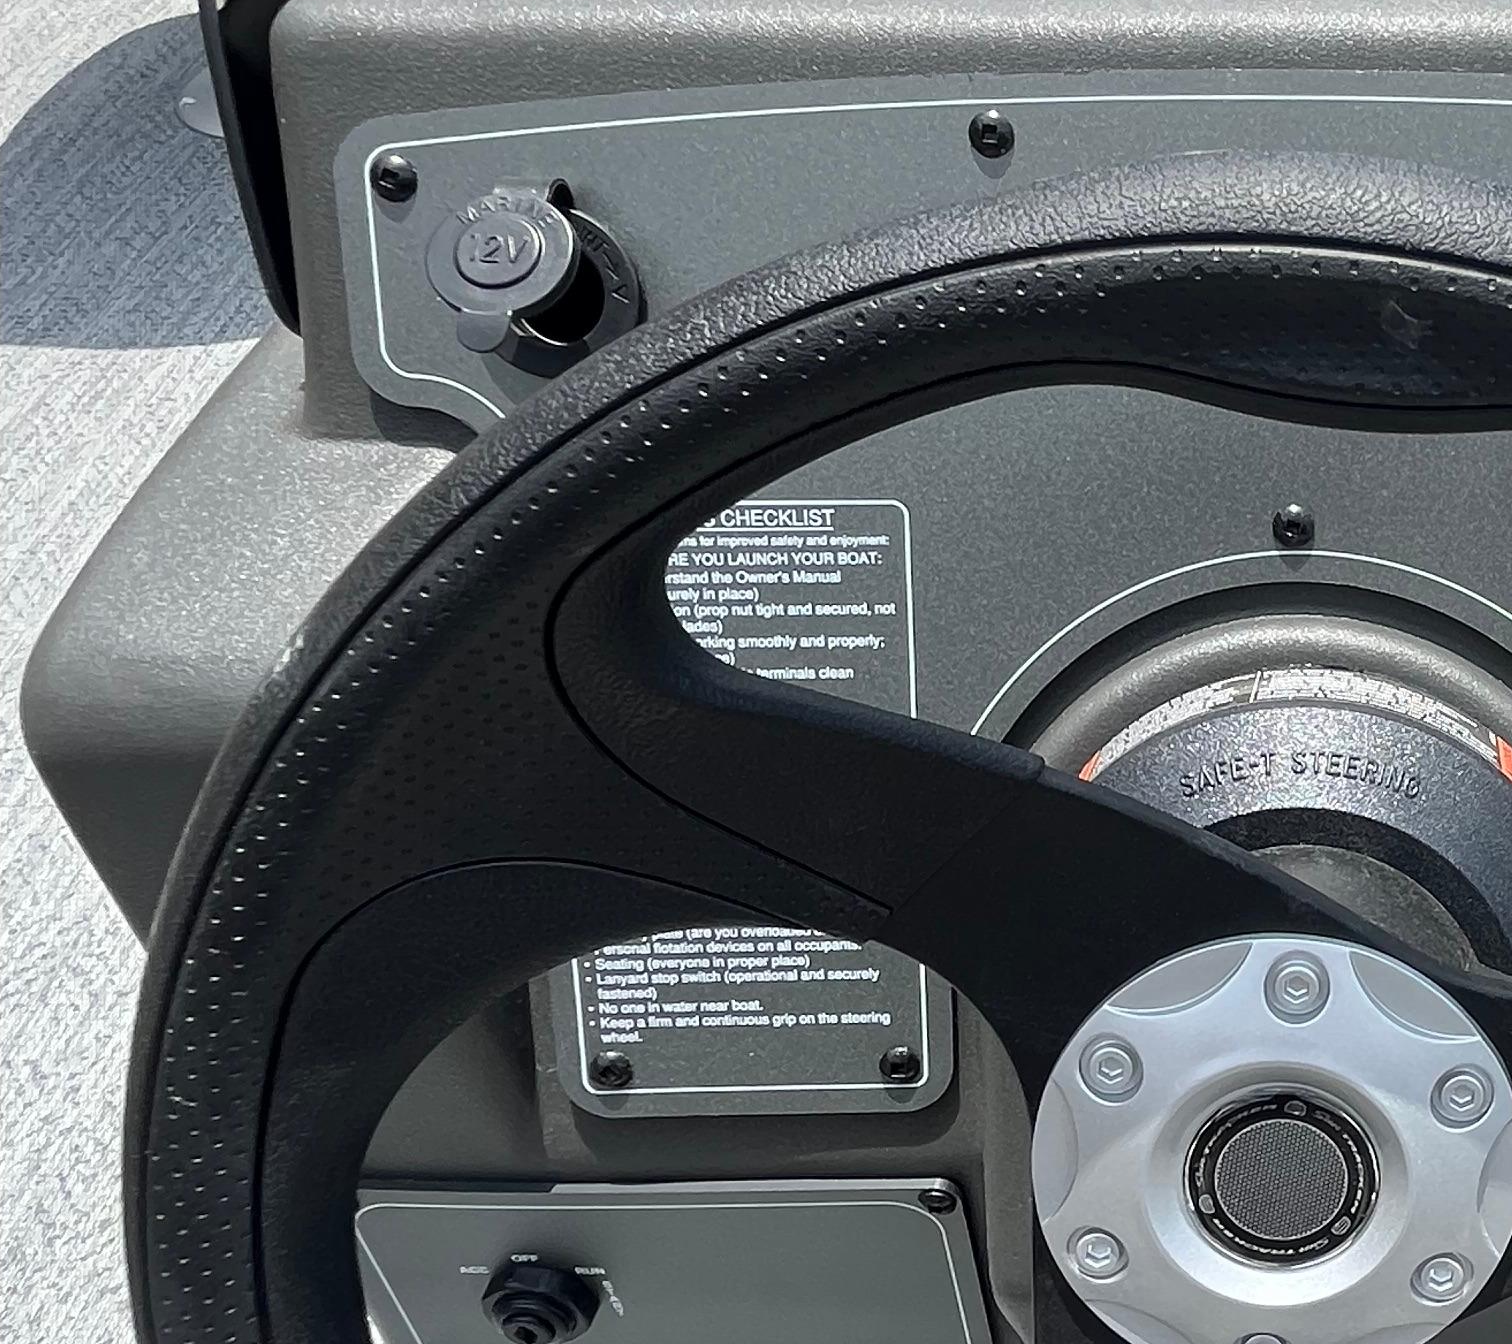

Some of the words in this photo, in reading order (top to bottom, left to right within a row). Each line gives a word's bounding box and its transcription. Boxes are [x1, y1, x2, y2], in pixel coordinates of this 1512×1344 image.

[469, 234, 532, 264] 12V
[720, 508, 835, 527] CHECKLIST
[699, 535, 715, 546] for
[717, 535, 769, 548] improved
[770, 535, 804, 548] safety
[806, 535, 828, 546] and
[691, 552, 724, 566] YOU
[727, 552, 788, 566] LAUNCH
[791, 552, 835, 565] YOUR
[838, 551, 883, 565] BOAT:
[665, 571, 709, 584] rstand
[711, 571, 733, 584] the
[735, 570, 790, 584] Owner's
[793, 570, 842, 584] Manual
[667, 588, 700, 602] urely
[703, 587, 716, 600] in
[719, 587, 760, 603] place)
[694, 605, 729, 619] (prop
[731, 604, 754, 616] nut
[755, 603, 784, 619] tight
[787, 602, 813, 616] and
[814, 602, 872, 616] secured,
[874, 602, 896, 616] not
[682, 619, 723, 635] lades)
[696, 636, 736, 650] rking
[738, 635, 797, 650] smoothly
[799, 634, 826, 648] and
[818, 666, 854, 679] clean
[1179, 752, 1275, 799] SAFE-T
[1290, 752, 1422, 801] STEERING
[686, 928, 713, 940] (are
[715, 928, 738, 940] you
[594, 943, 651, 955] ersonal
[653, 942, 704, 954] flotation
[706, 941, 755, 953] devices
[757, 941, 774, 952] on
[776, 940, 792, 952] all
[595, 958, 644, 971] Seating
[647, 956, 710, 971] (everyone
[712, 956, 725, 967] in
[727, 958, 769, 970] proper
[771, 953, 811, 968] place)
[595, 972, 649, 986] Lanyard
[651, 972, 679, 985] stop
[681, 970, 721, 983] switch
[724, 969, 798, 984] (operational
[800, 968, 825, 980] and
[827, 967, 880, 982] securely
[597, 987, 658, 1000] fastened)
[598, 1002, 619, 1014] No
[620, 1003, 646, 1013] one
[647, 1001, 660, 1013] in
[662, 1001, 699, 1012] water
[700, 1001, 730, 1012] near
[731, 999, 764, 1011] boat.
[599, 1017, 634, 1030] Keep
[637, 1018, 646, 1028] a
[648, 1016, 673, 1028] firm
[675, 1015, 699, 1027] and
[701, 1014, 770, 1027] continuous
[772, 1013, 796, 1027] grip
[799, 1013, 815, 1024] on
[817, 1012, 838, 1024] the
[840, 1011, 891, 1026] steering
[600, 1030, 644, 1043] wheel.
[510, 1254, 538, 1262] OFF
